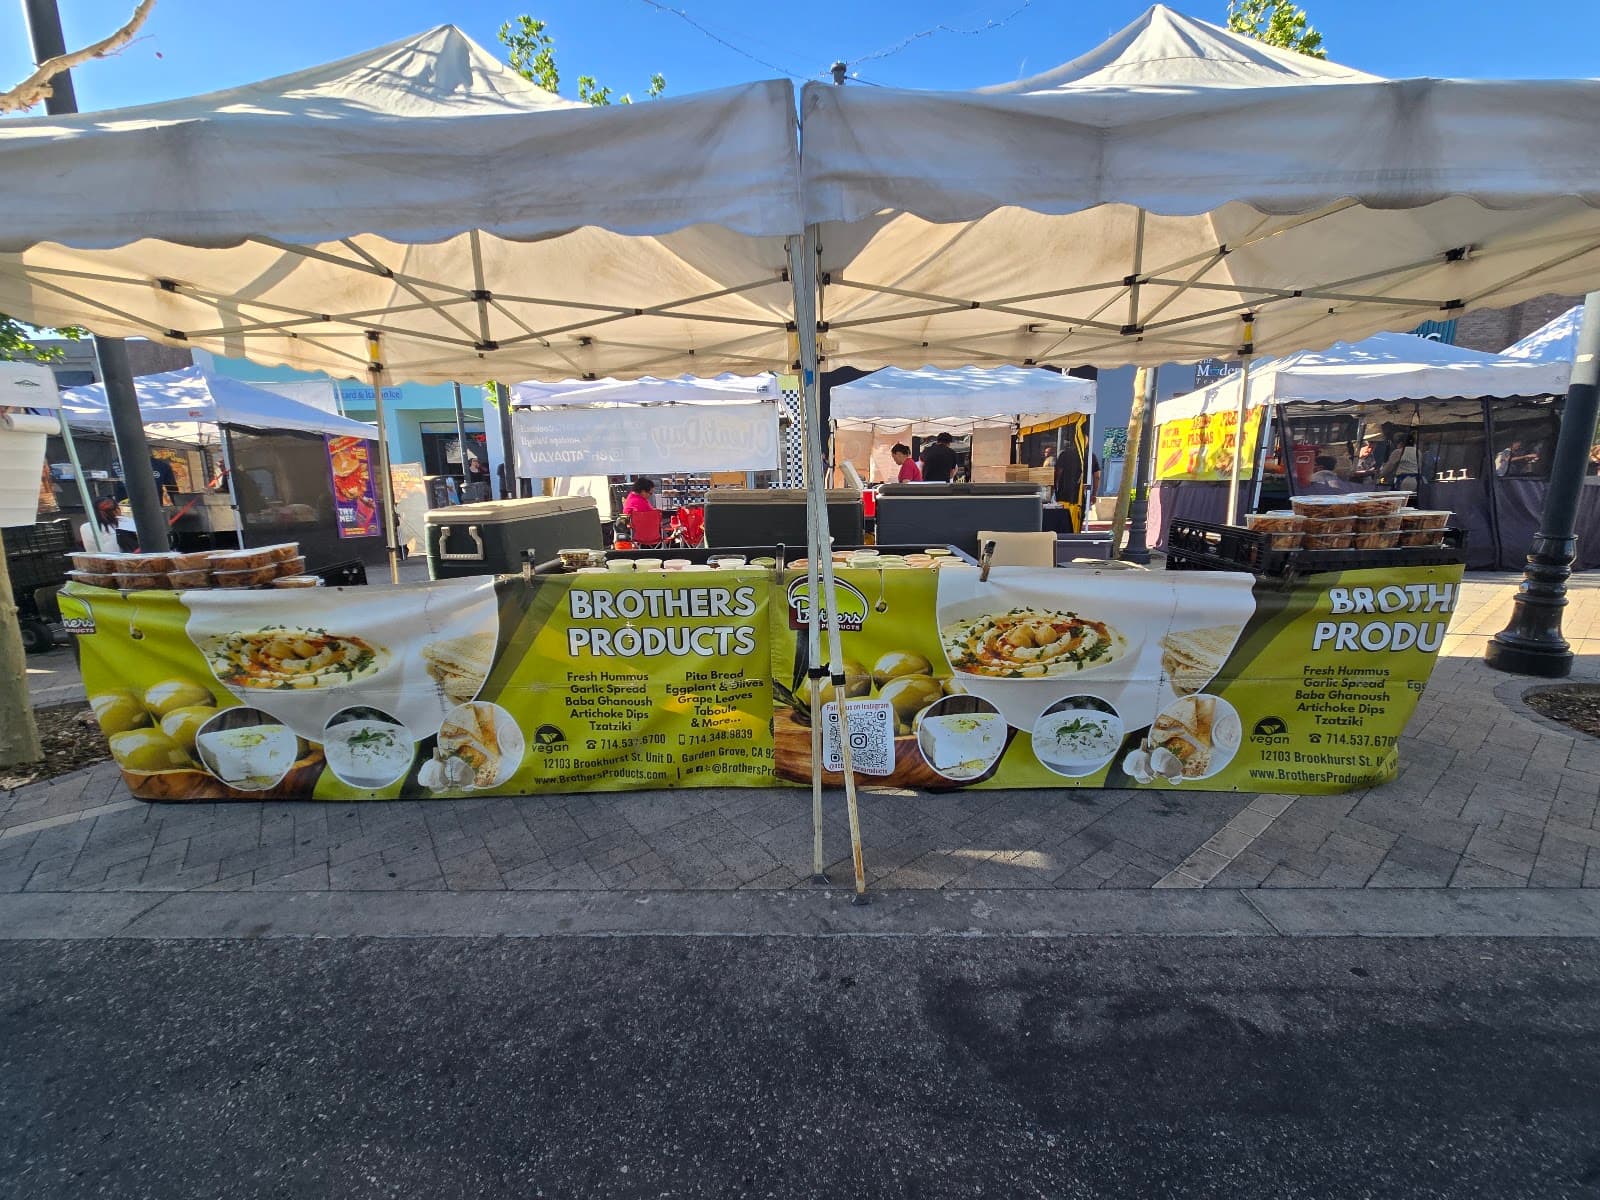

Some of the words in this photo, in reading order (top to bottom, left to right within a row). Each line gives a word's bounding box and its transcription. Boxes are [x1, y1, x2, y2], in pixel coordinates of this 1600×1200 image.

[569, 586, 756, 620] BROTHERS
[1329, 583, 1460, 615] BROTH
[568, 626, 756, 656] PRODUCTS
[1312, 621, 1445, 652] PRODU
[567, 672, 597, 681] Fresh
[600, 672, 648, 681] Hummus
[686, 672, 708, 681] Pita
[710, 668, 744, 680] Bread
[1304, 666, 1334, 676] Fresh
[1338, 666, 1390, 676] Hummus
[570, 684, 604, 694] Garlic
[606, 684, 646, 695] Spread
[666, 684, 716, 696] Eggplant
[719, 682, 728, 692] &
[1304, 678, 1338, 688] Garlic
[1341, 678, 1386, 690] Spread
[565, 696, 594, 706] Baba
[598, 696, 652, 706] Ghanoush
[678, 696, 712, 705] Grape
[716, 692, 752, 704] Leaves
[1296, 690, 1325, 700] Baba
[1328, 690, 1390, 702] Ghanoush
[570, 708, 624, 718] Artichoke
[626, 708, 648, 721] Dips
[694, 704, 736, 716] Taboule
[1296, 702, 1356, 713] Artichoke
[1358, 704, 1384, 716] Dips
[590, 720, 632, 731] Tzatziki
[690, 718, 700, 728] &
[702, 718, 741, 728] More...
[1314, 715, 1363, 726] Tzatziki
[689, 729, 753, 745] 714.348.9839
[1250, 735, 1290, 746] vegan
[532, 743, 569, 754] vegan
[544, 758, 570, 768] 12103
[574, 753, 628, 768] Brookhurst
[632, 752, 642, 762] St.
[646, 752, 664, 764] Unit
[682, 749, 715, 762] Garden
[718, 747, 748, 758] Grove,
[751, 747, 763, 758] CA
[1260, 750, 1290, 762] 12103
[1294, 752, 1356, 766] Brookhurst
[1376, 756, 1385, 767] U
[534, 768, 666, 784] www.BrothersProducts.com
